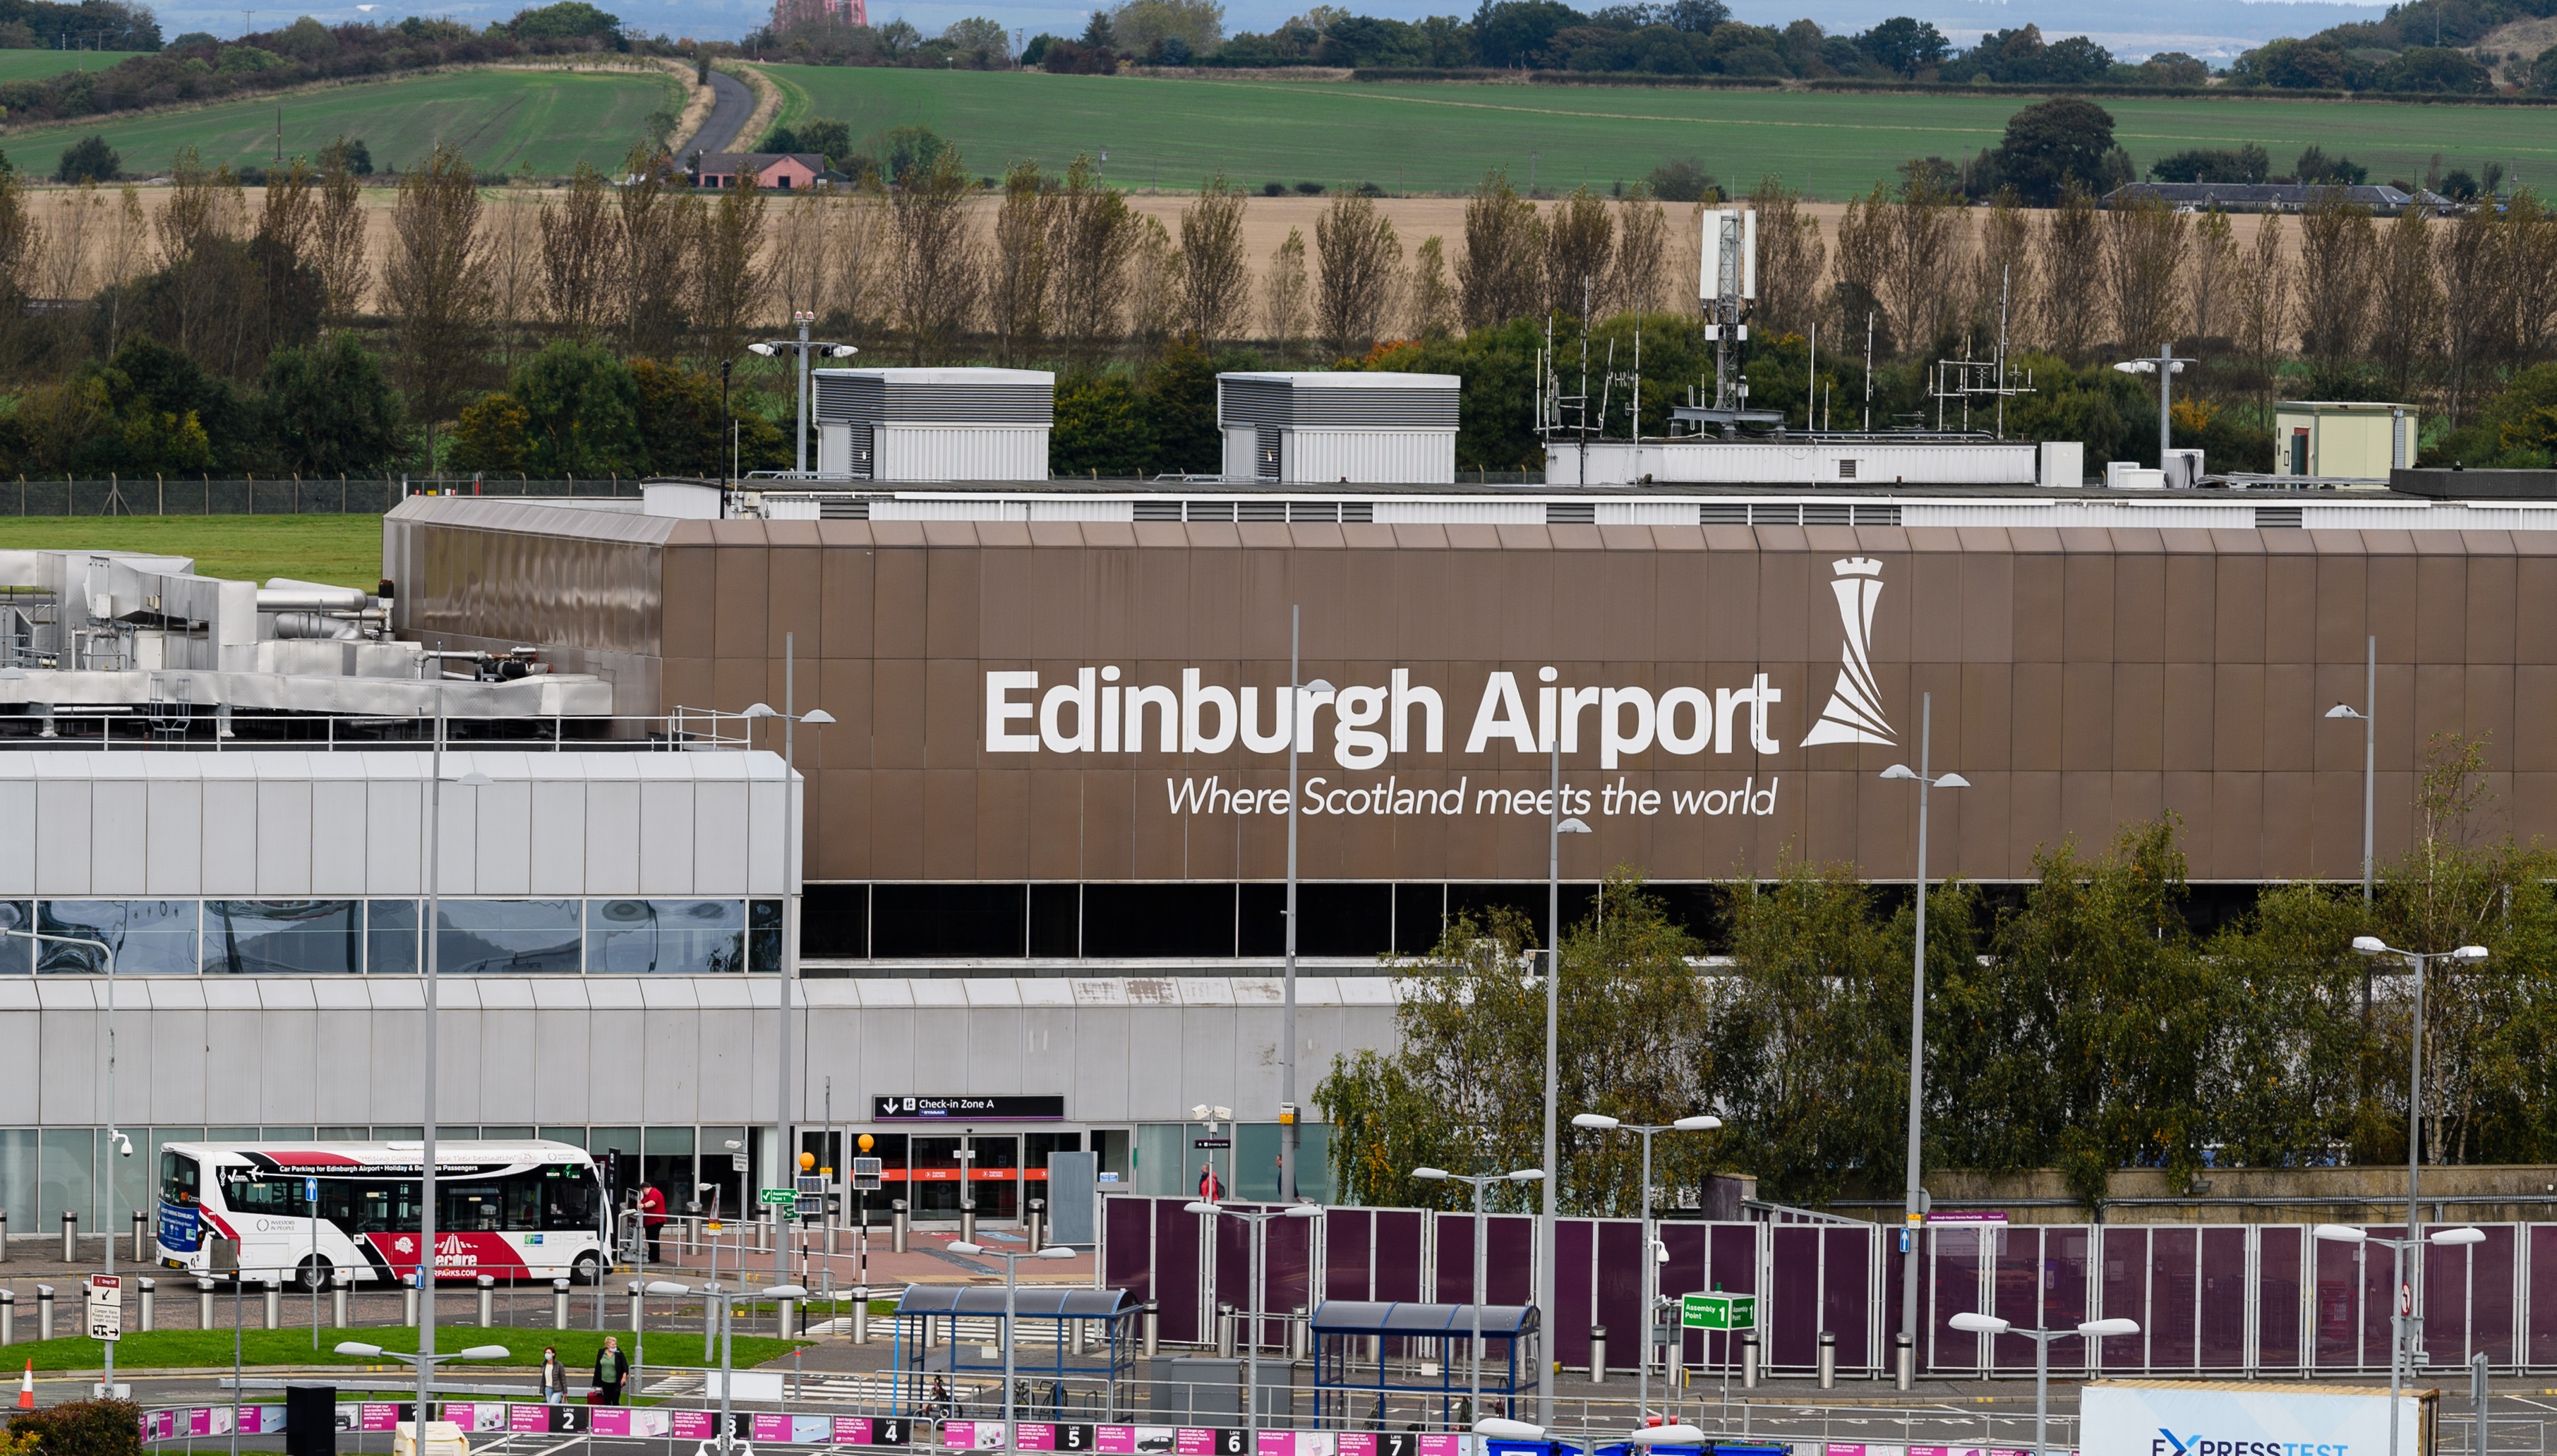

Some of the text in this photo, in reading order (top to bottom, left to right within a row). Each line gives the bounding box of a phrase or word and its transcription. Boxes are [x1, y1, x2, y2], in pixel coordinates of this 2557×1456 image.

[986, 665, 1782, 770] Edinburgh Airport
[1167, 775, 1779, 816] Where Scotland meets the world
[919, 1100, 994, 1109] Check-in Zone A
[435, 1254, 477, 1266] ecure
[1686, 1304, 1716, 1313] Assembly
[1719, 1306, 1725, 1321] 1
[1750, 1305, 1753, 1320] 1
[562, 1412, 574, 1429] 2
[729, 1419, 737, 1436] 3
[885, 1425, 897, 1441] 4
[1069, 1431, 1080, 1448] 5
[1229, 1436, 1241, 1452] 6
[1390, 1440, 1402, 1456] 7
[2153, 1428, 2348, 1456] EXPRESSTEST
